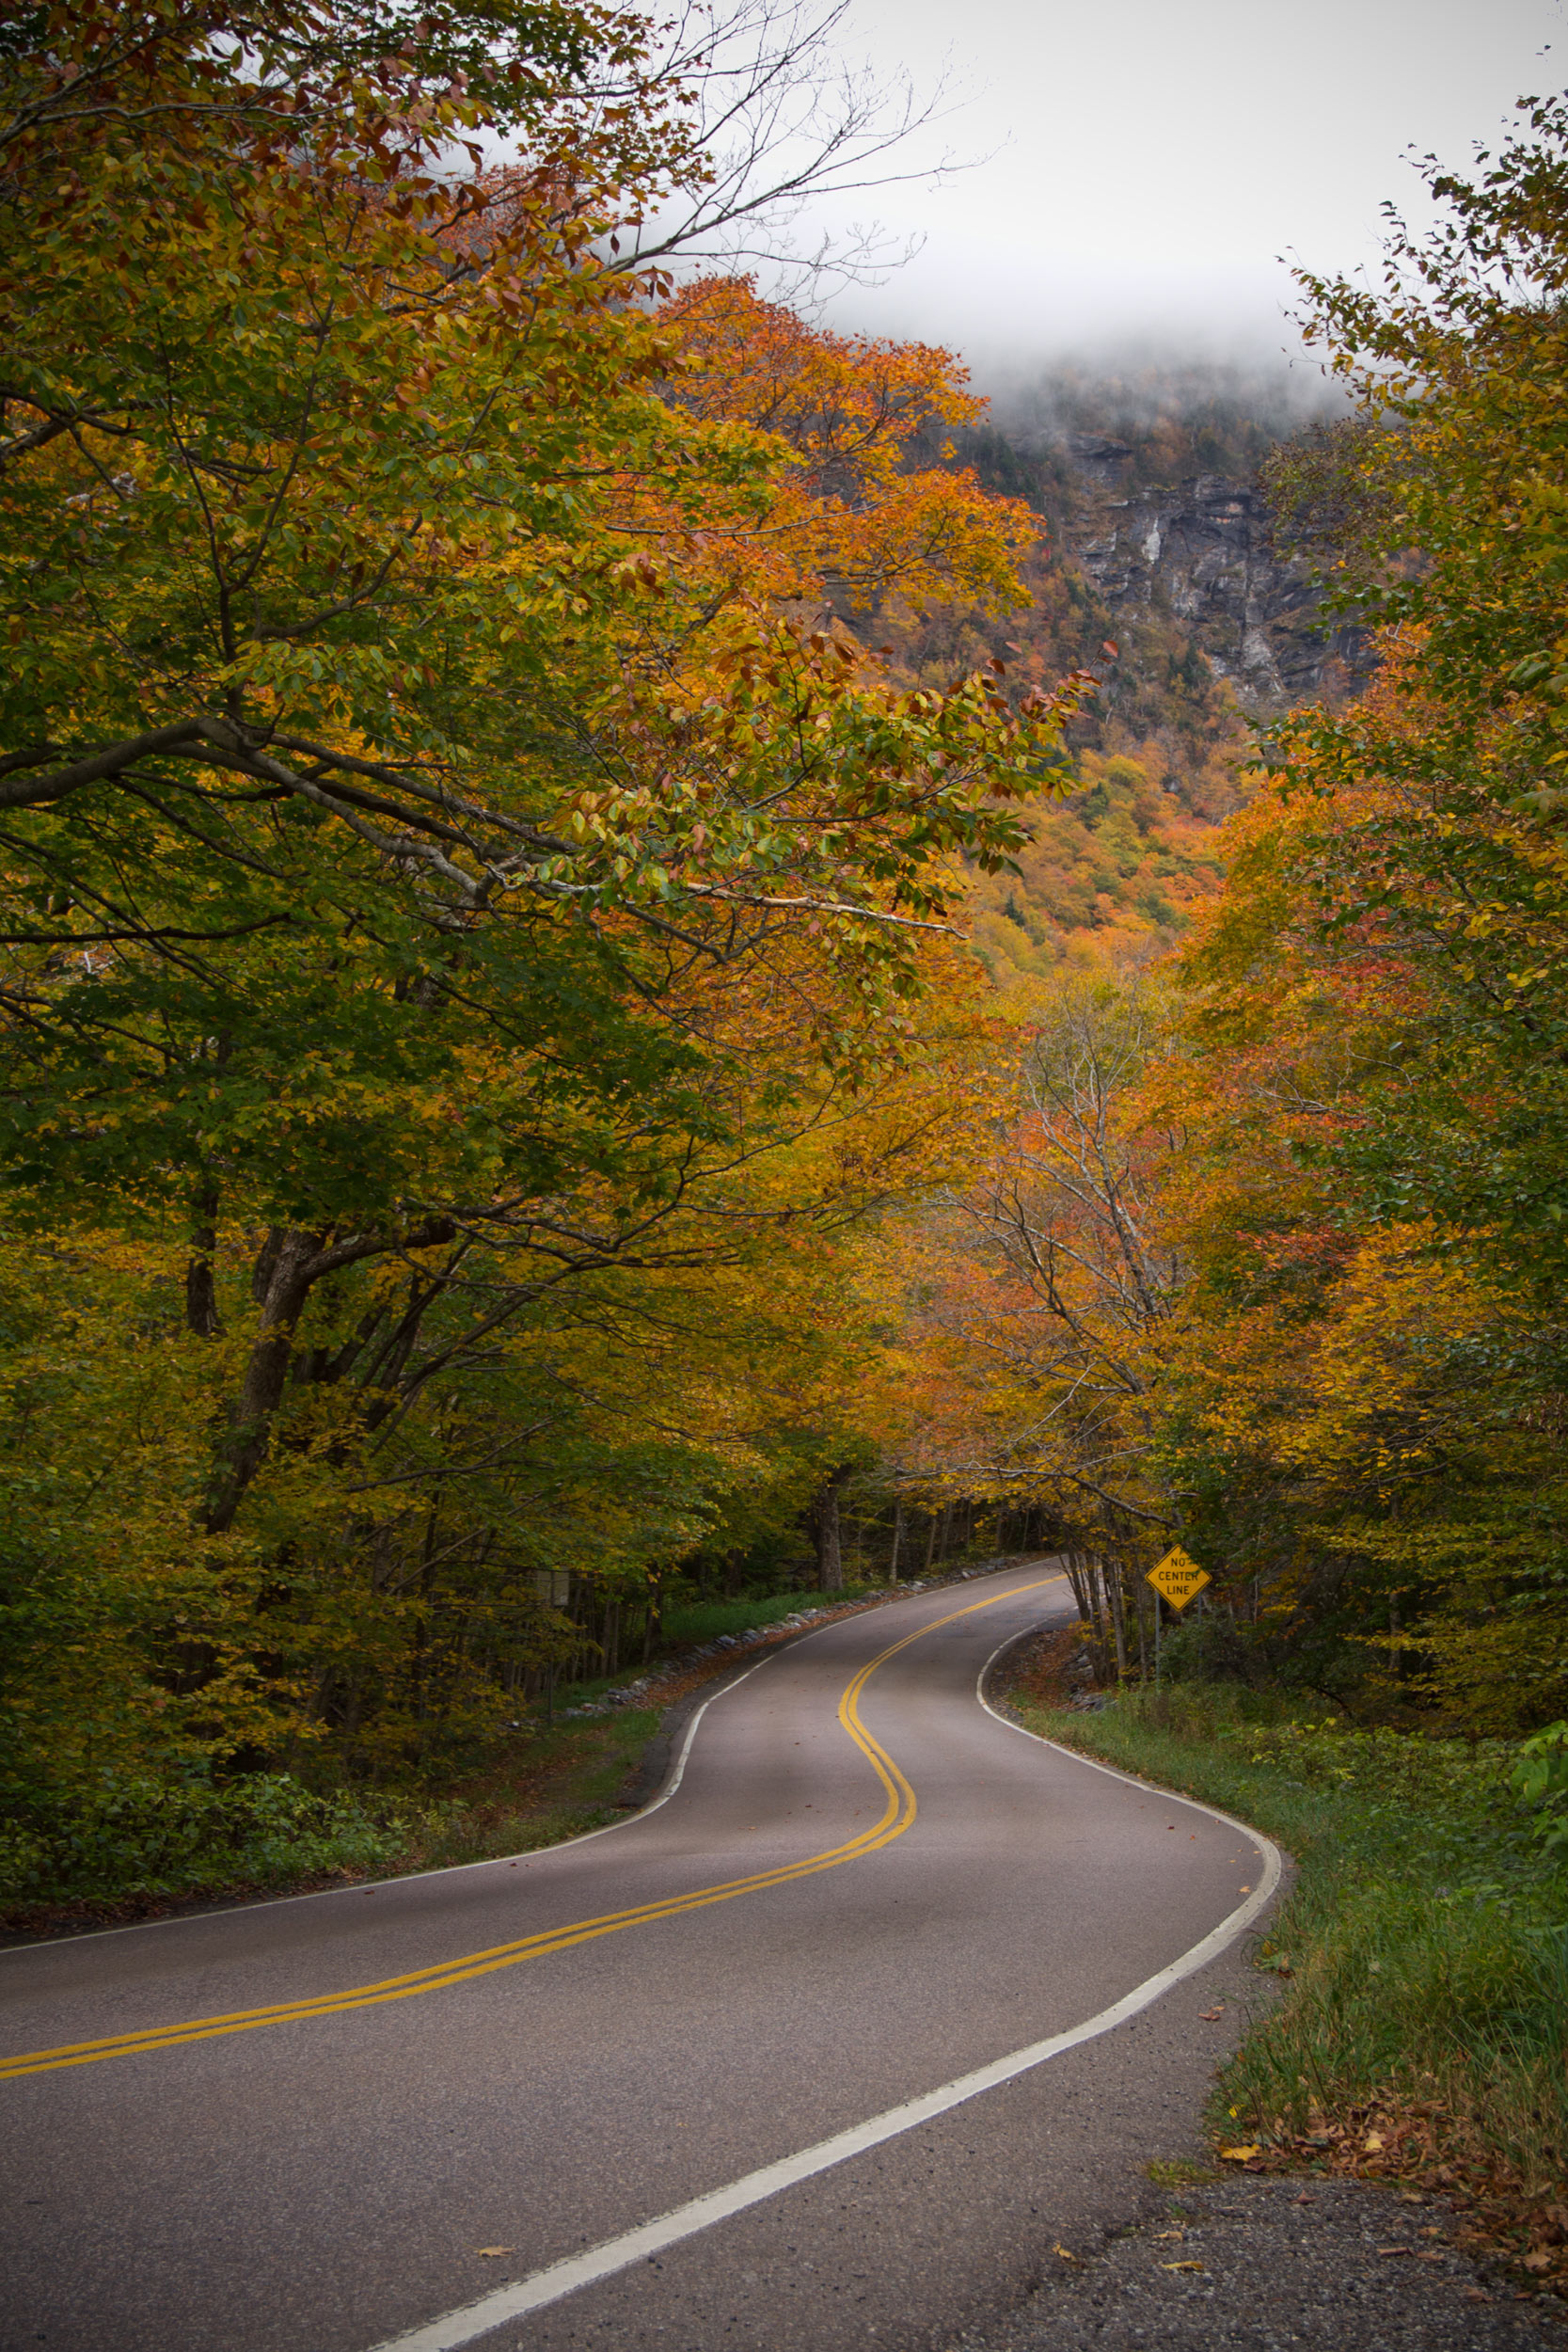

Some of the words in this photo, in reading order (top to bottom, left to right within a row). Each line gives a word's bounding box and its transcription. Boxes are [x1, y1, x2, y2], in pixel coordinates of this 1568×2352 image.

[1171, 1558, 1185, 1566] NO
[1158, 1571, 1198, 1581] CENTER
[1166, 1585, 1190, 1595] LINE
